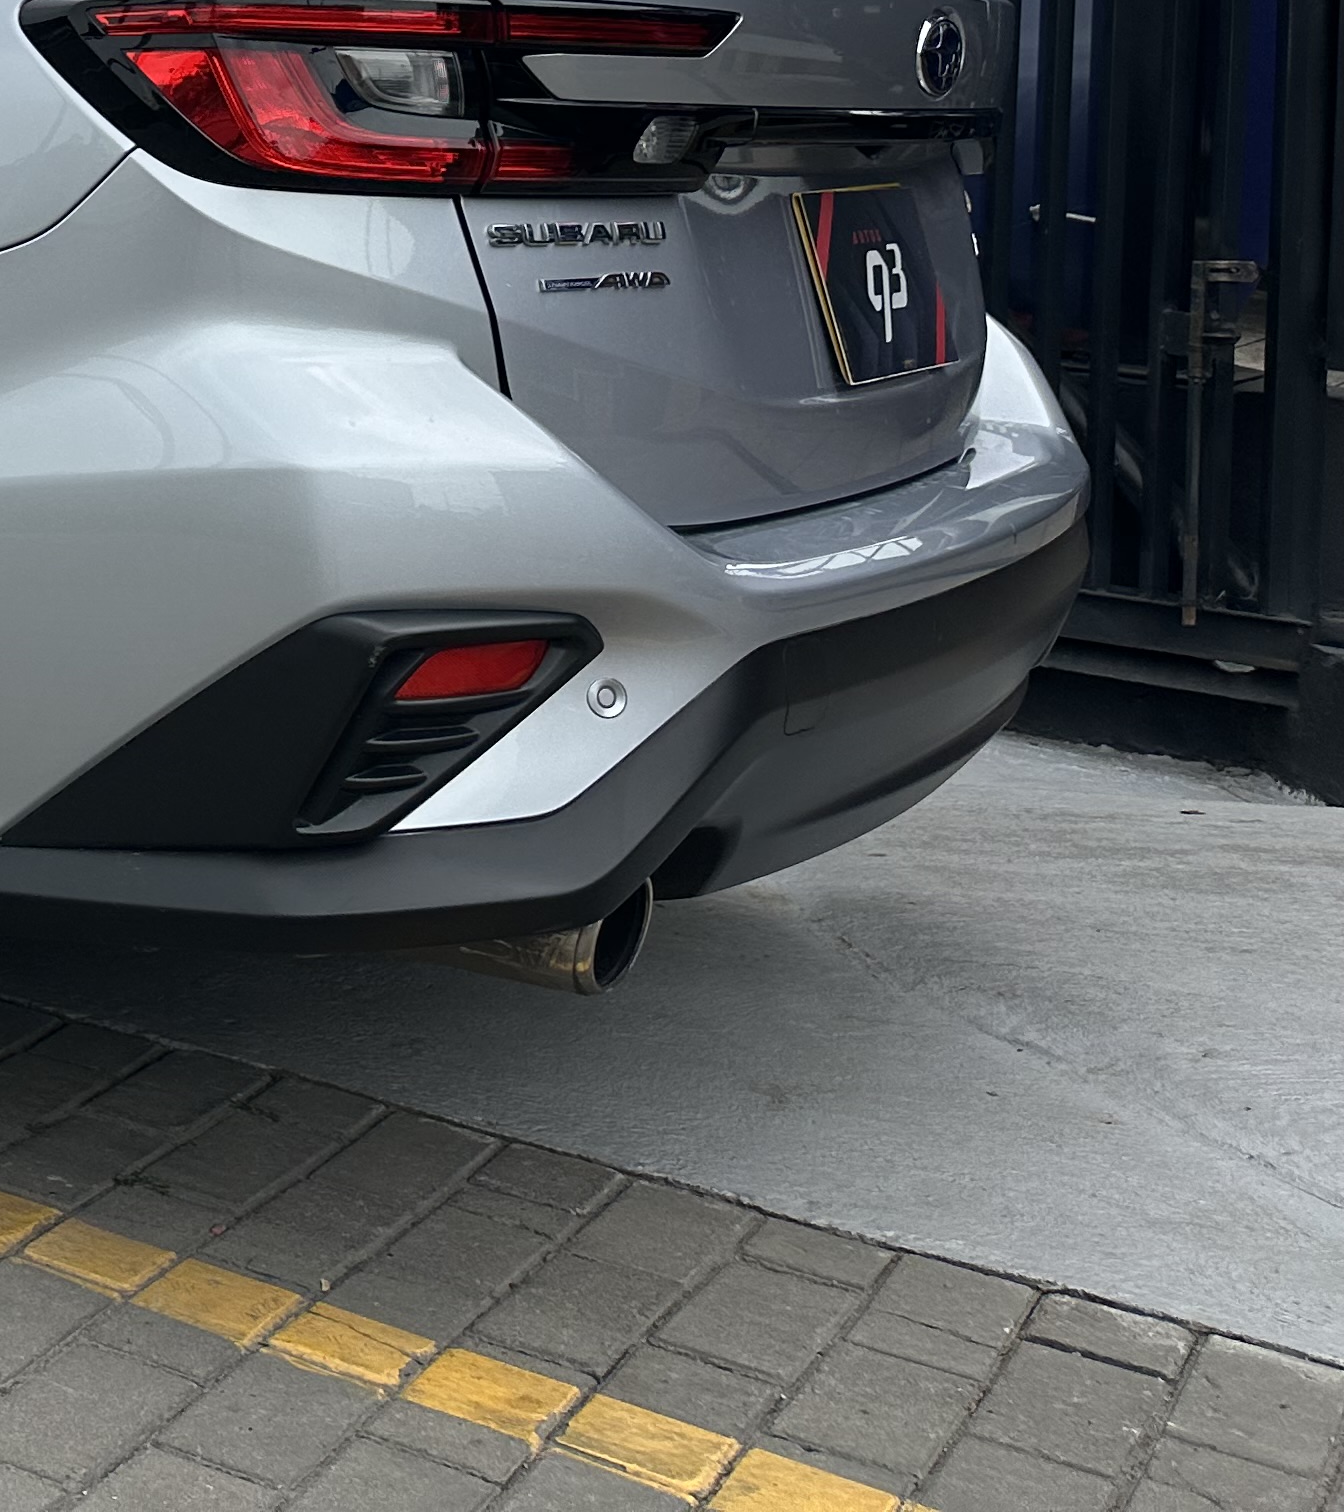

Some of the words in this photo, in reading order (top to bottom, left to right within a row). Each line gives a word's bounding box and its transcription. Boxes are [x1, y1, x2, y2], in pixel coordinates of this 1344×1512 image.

[486, 221, 667, 248] SUBARU
[595, 270, 672, 292] AWD
[865, 242, 909, 343] 93
